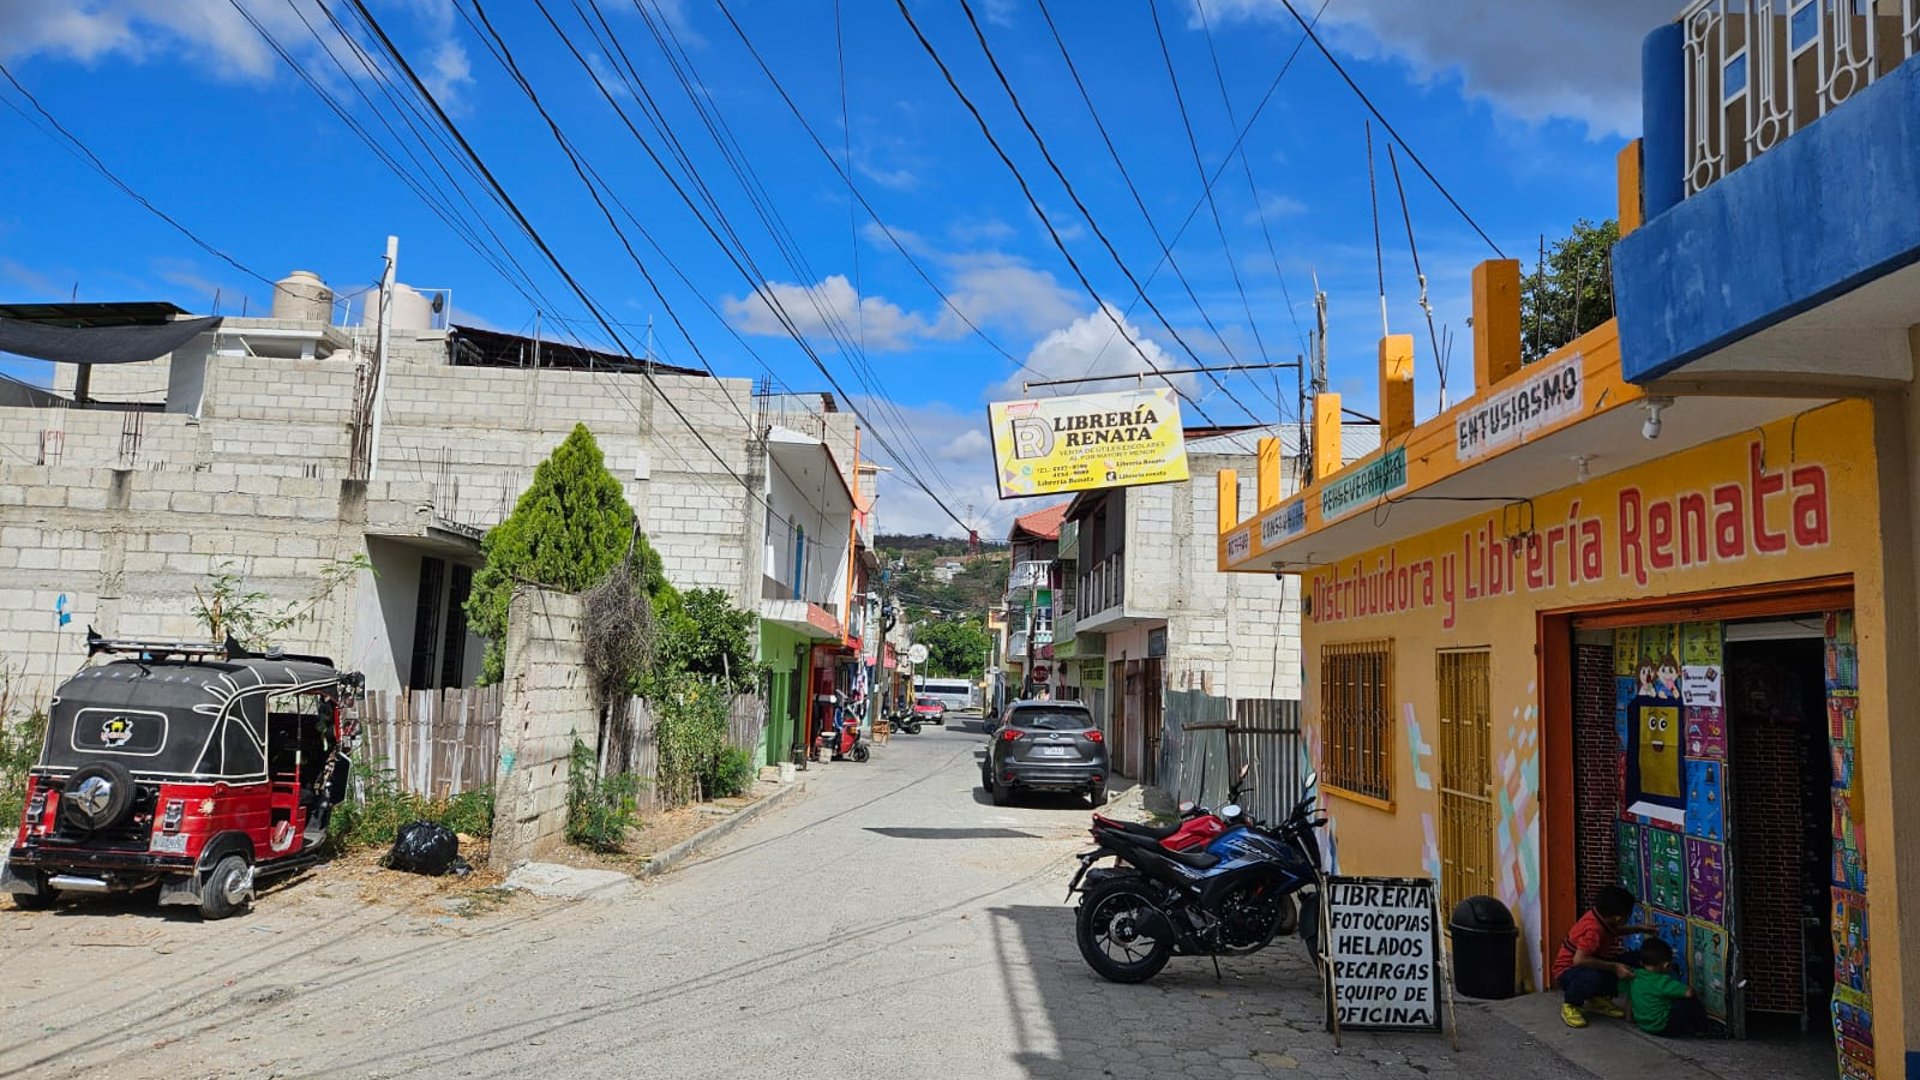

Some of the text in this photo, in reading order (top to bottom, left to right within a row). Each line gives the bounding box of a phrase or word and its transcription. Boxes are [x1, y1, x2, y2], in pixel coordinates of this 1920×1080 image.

[1053, 404, 1158, 432] LIBRERÍA
[1459, 366, 1577, 450] ENTUSIASMO
[1066, 426, 1153, 447] RENATA
[1059, 448, 1084, 456] VENTA
[1313, 441, 1828, 629] Distribuidora y Librería Renata
[1330, 885, 1429, 909] LIBRERIA
[1331, 912, 1430, 932] FOTOCOPIAS
[1338, 935, 1423, 958] HELADOS
[1333, 961, 1429, 980] RECARGAS
[1336, 984, 1428, 1004] EQUIPO DE
[1336, 1007, 1430, 1024] OFICINA
